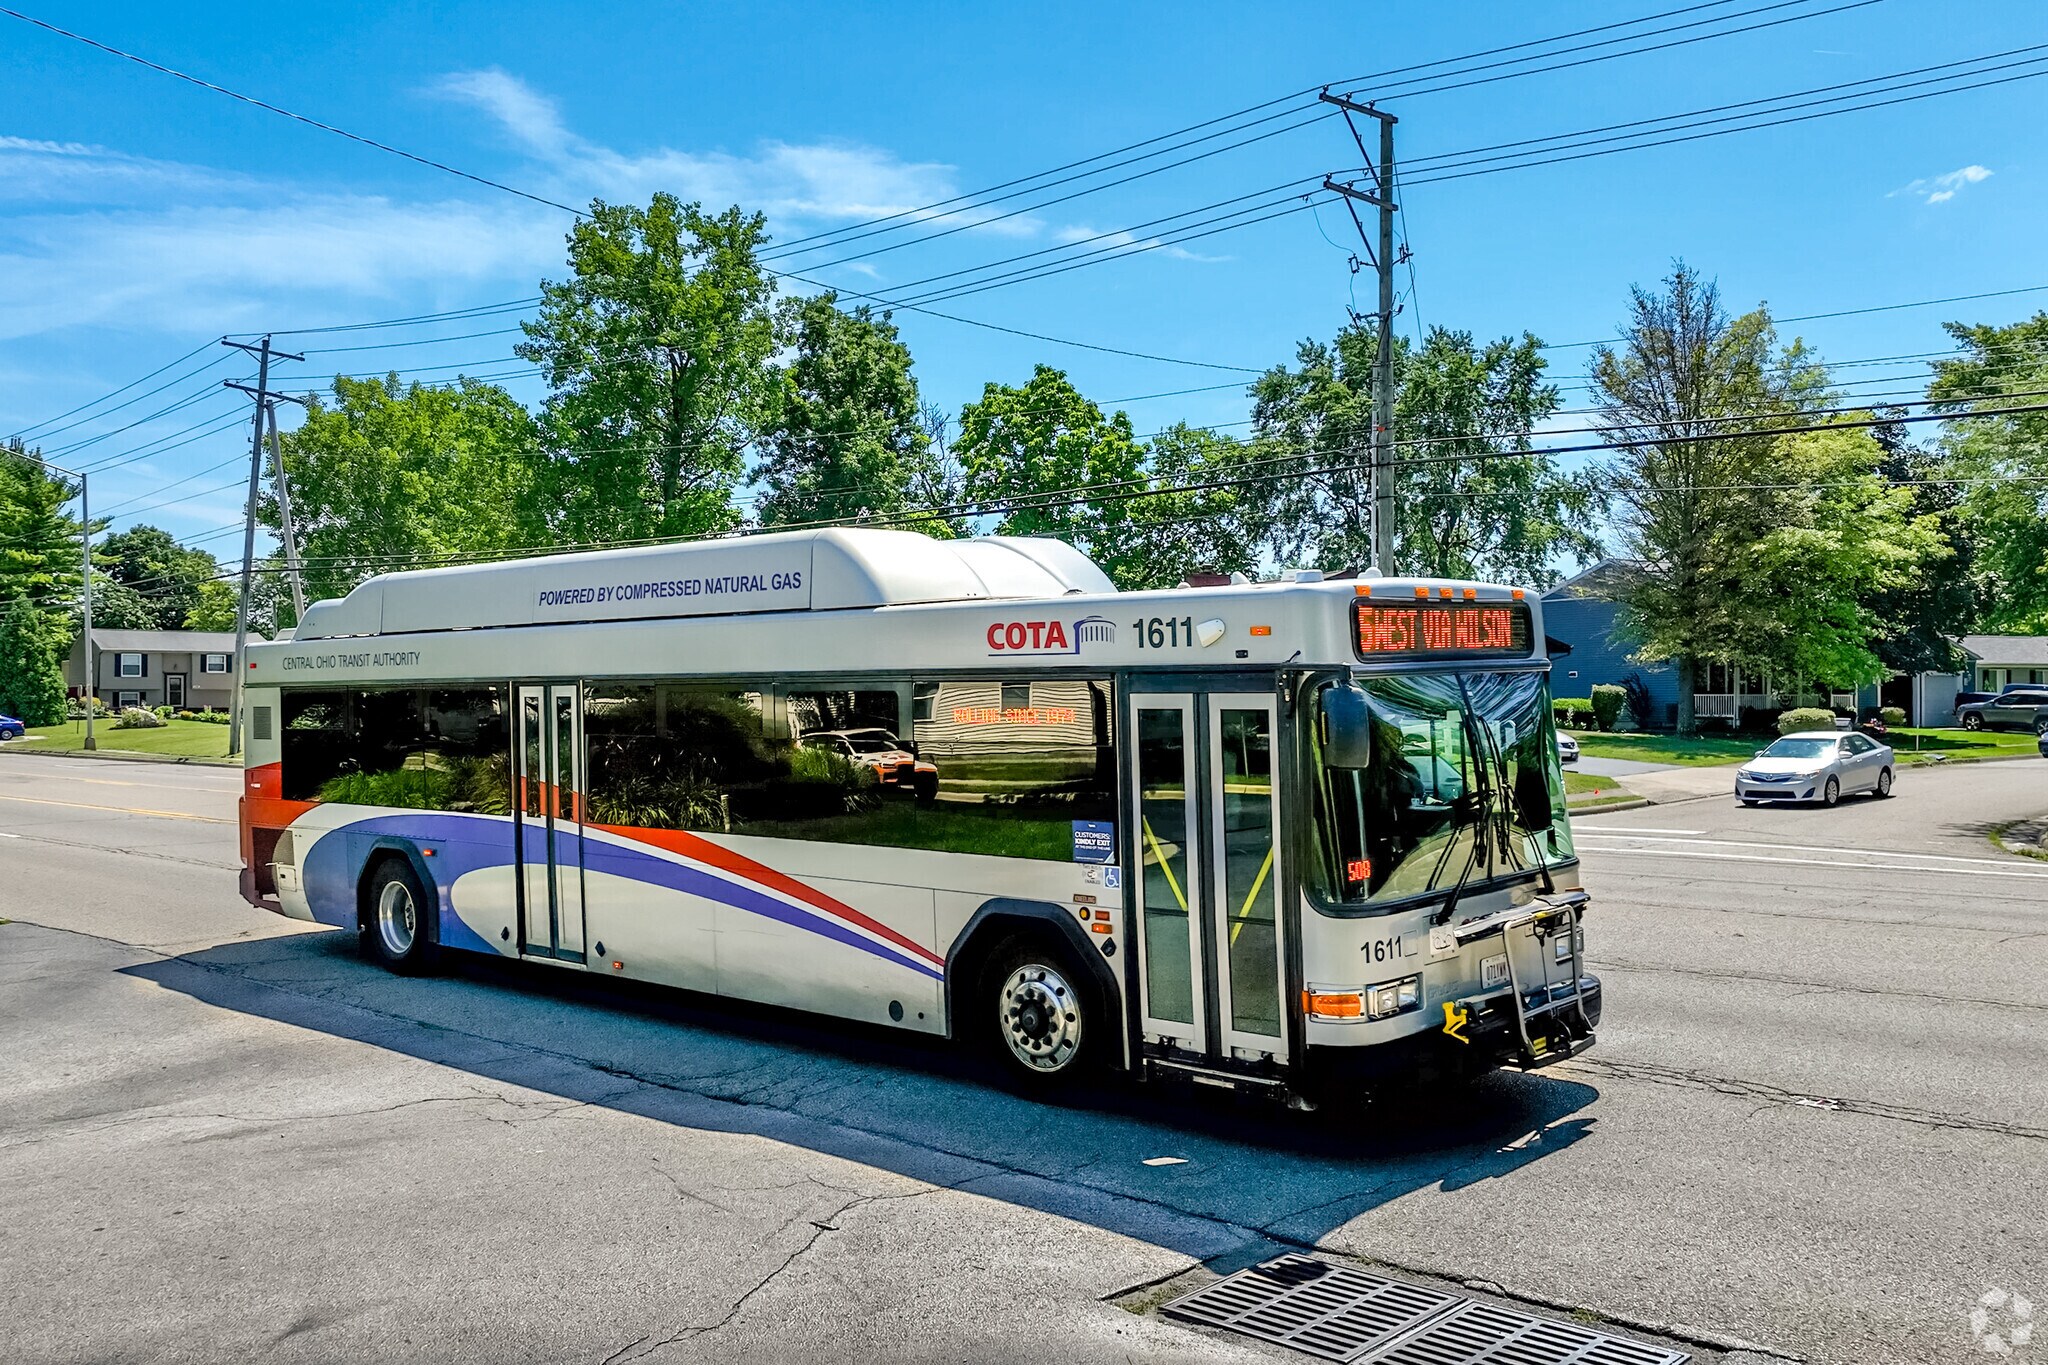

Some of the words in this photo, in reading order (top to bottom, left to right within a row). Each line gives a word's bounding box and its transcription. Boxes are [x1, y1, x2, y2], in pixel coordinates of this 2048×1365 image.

[539, 587, 595, 607] POWERED
[597, 585, 615, 603] BY
[615, 579, 701, 601] COMPRESSED
[704, 574, 767, 594] NATURAL
[771, 571, 802, 590] GAS
[986, 620, 1069, 650] COTA
[1132, 616, 1192, 649] 1611
[1422, 609, 1452, 648] VIA
[1456, 609, 1512, 648] WILSON
[282, 656, 314, 671] CENTRAL
[316, 655, 336, 669] OHIO
[338, 653, 370, 668] TRANSIT
[373, 651, 421, 667] AUTHORITY
[1005, 708, 1041, 725] SINCE
[1074, 838, 1097, 846] KINDLY
[1360, 935, 1401, 964] 1611
